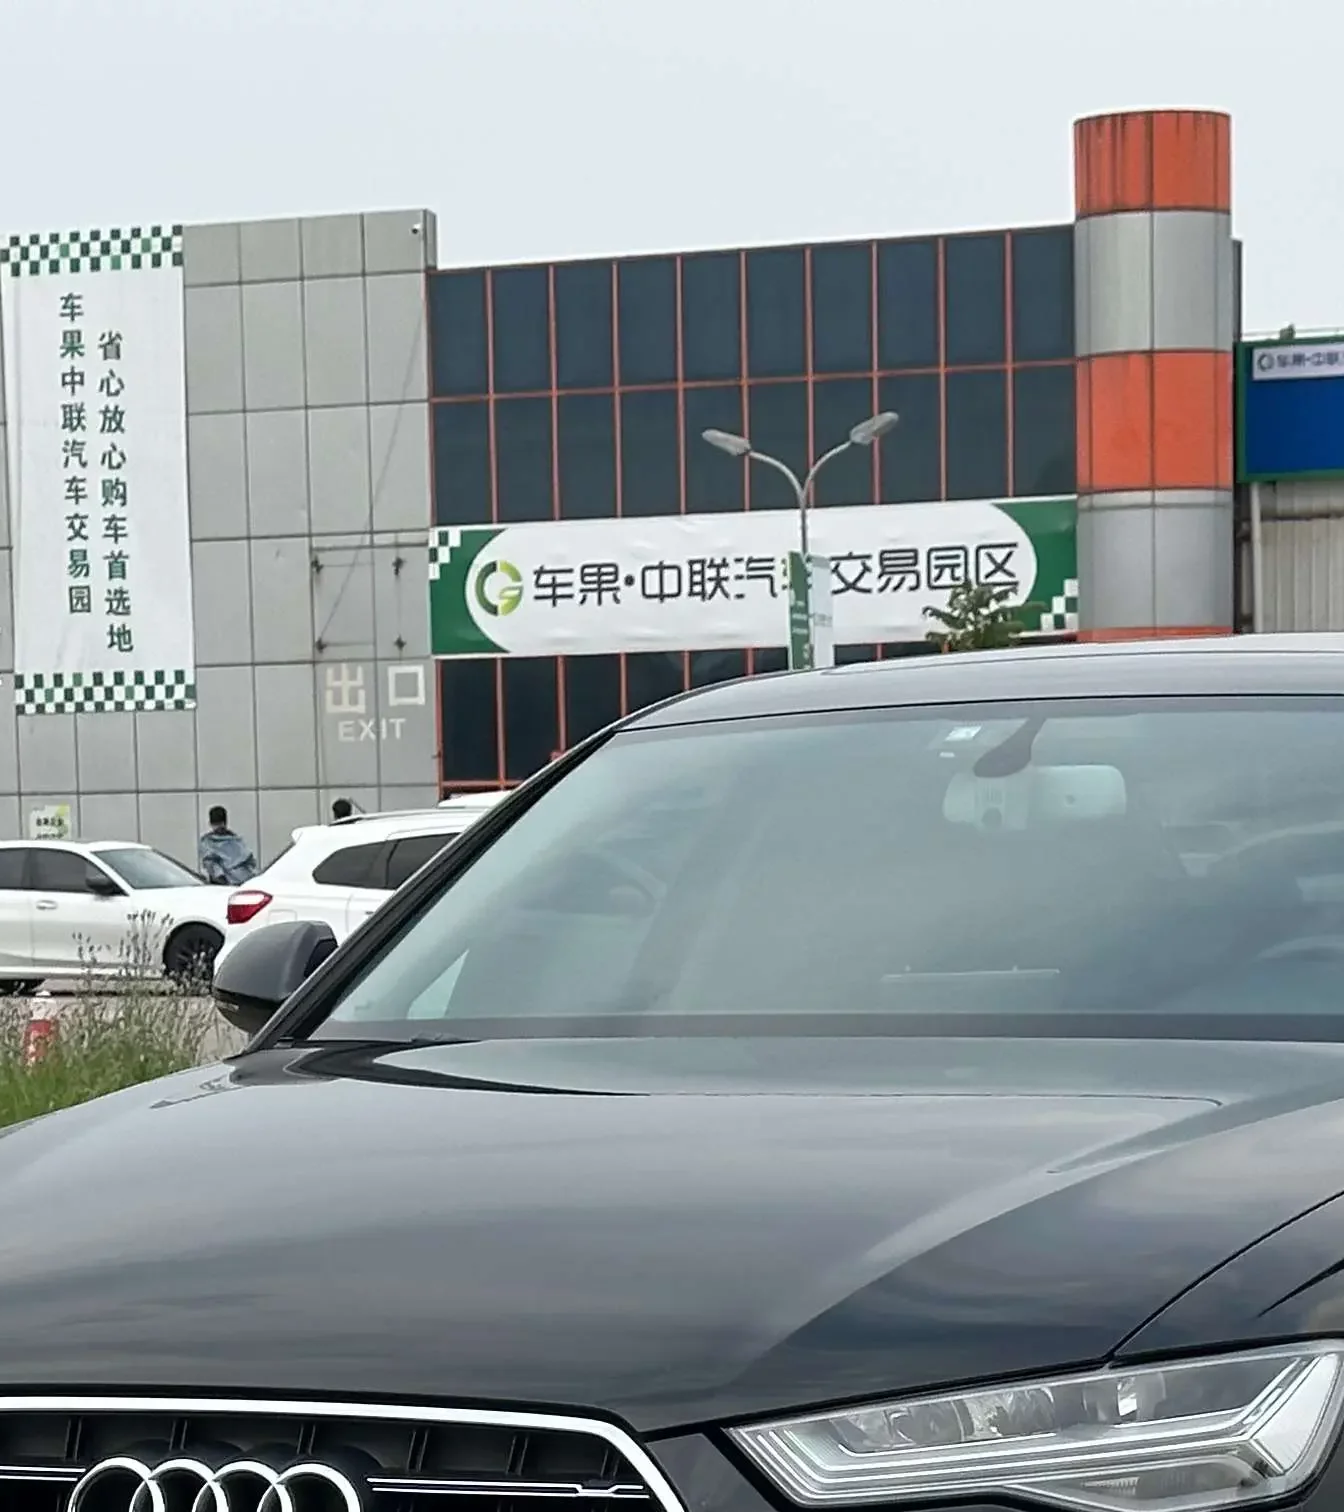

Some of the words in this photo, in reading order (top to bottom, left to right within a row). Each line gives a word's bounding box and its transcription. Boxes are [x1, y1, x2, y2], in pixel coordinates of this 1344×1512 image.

[59, 292, 92, 614] 车果中联汽车交易园
[97, 330, 134, 653] 省心放心购车首选地
[326, 662, 426, 714] 出口
[338, 718, 406, 741] EXIT
